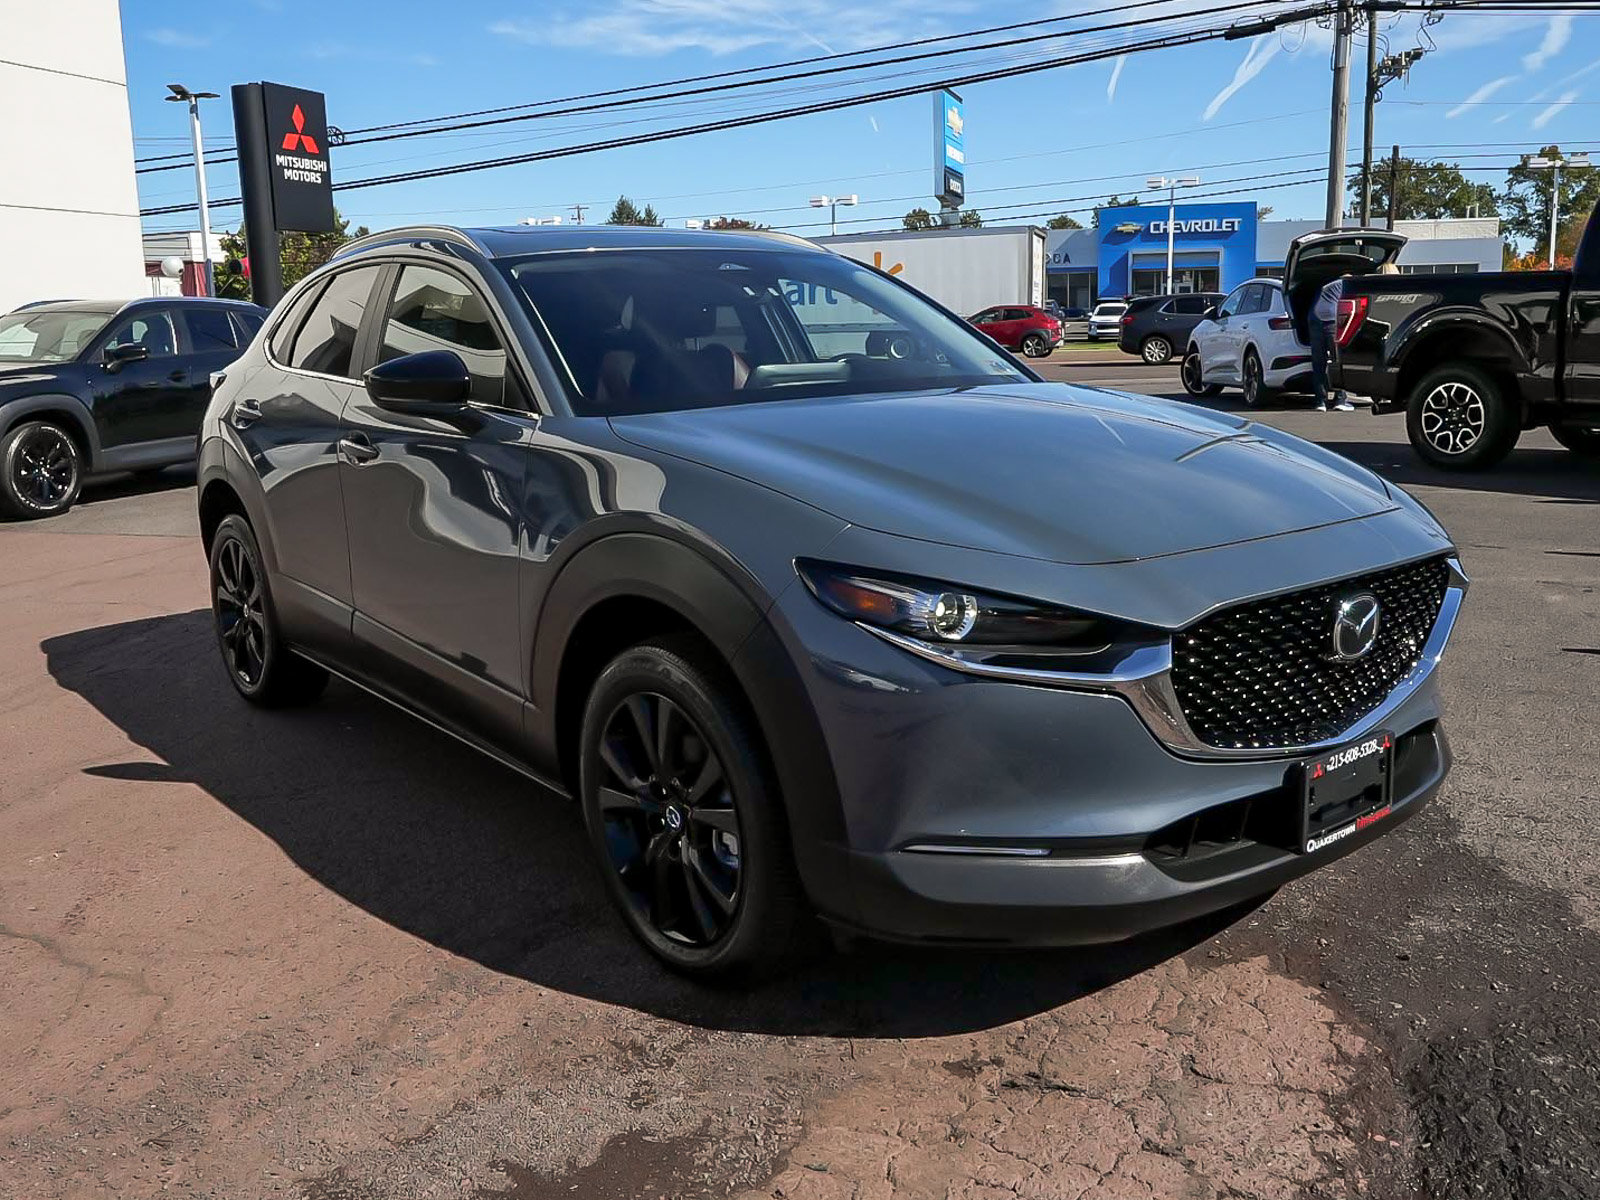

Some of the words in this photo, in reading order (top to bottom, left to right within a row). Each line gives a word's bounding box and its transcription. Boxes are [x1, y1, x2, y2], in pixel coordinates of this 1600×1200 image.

[275, 154, 328, 172] MITSUBISHI
[283, 168, 322, 184] MOTORS
[1150, 218, 1242, 234] CHEVROLET
